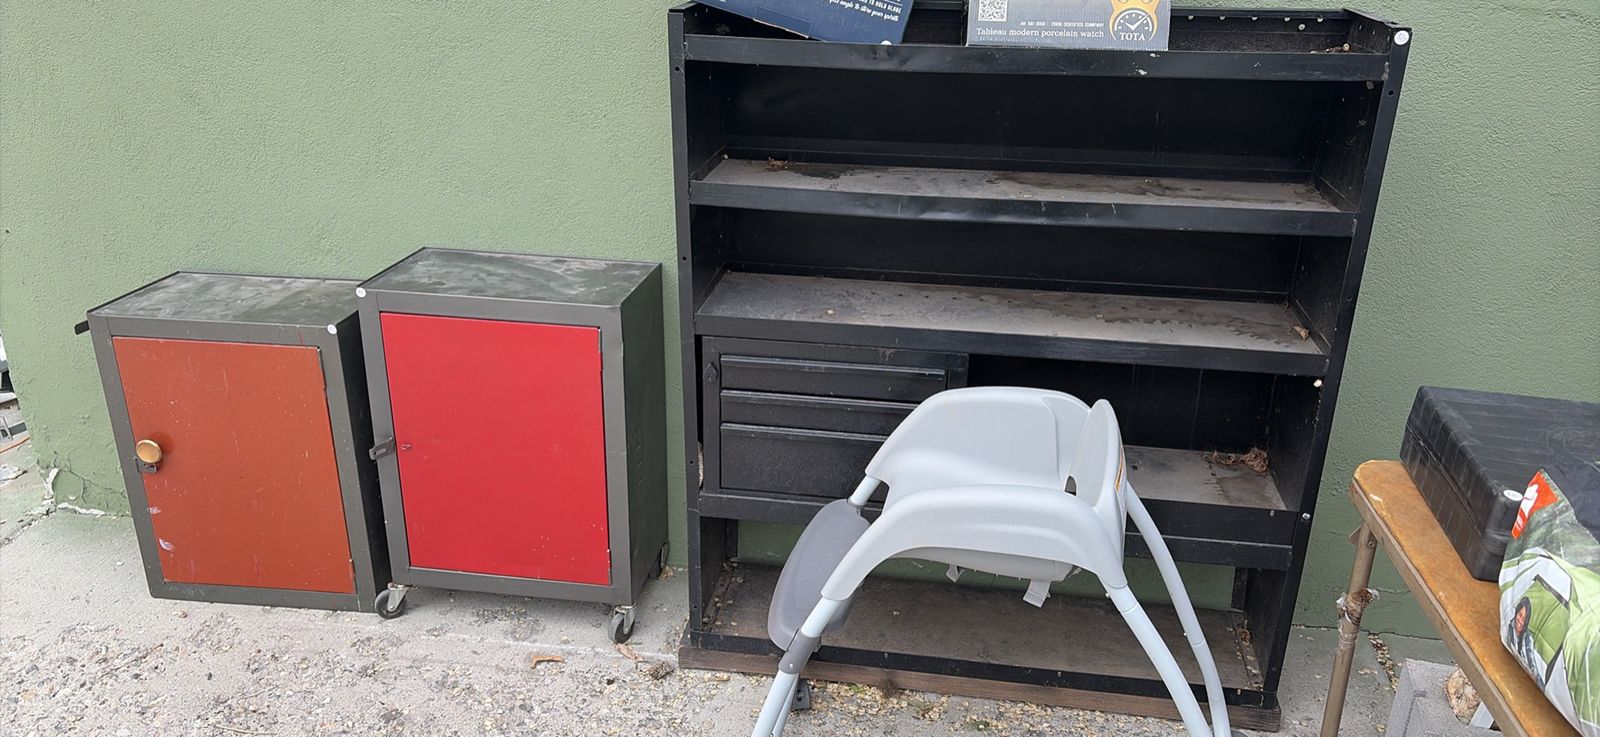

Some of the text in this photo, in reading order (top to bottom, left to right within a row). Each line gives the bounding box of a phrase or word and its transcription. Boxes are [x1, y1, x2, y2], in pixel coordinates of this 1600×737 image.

[976, 27, 1104, 38] Tableau modern porcelain watch
[1120, 32, 1145, 41] TOTA
